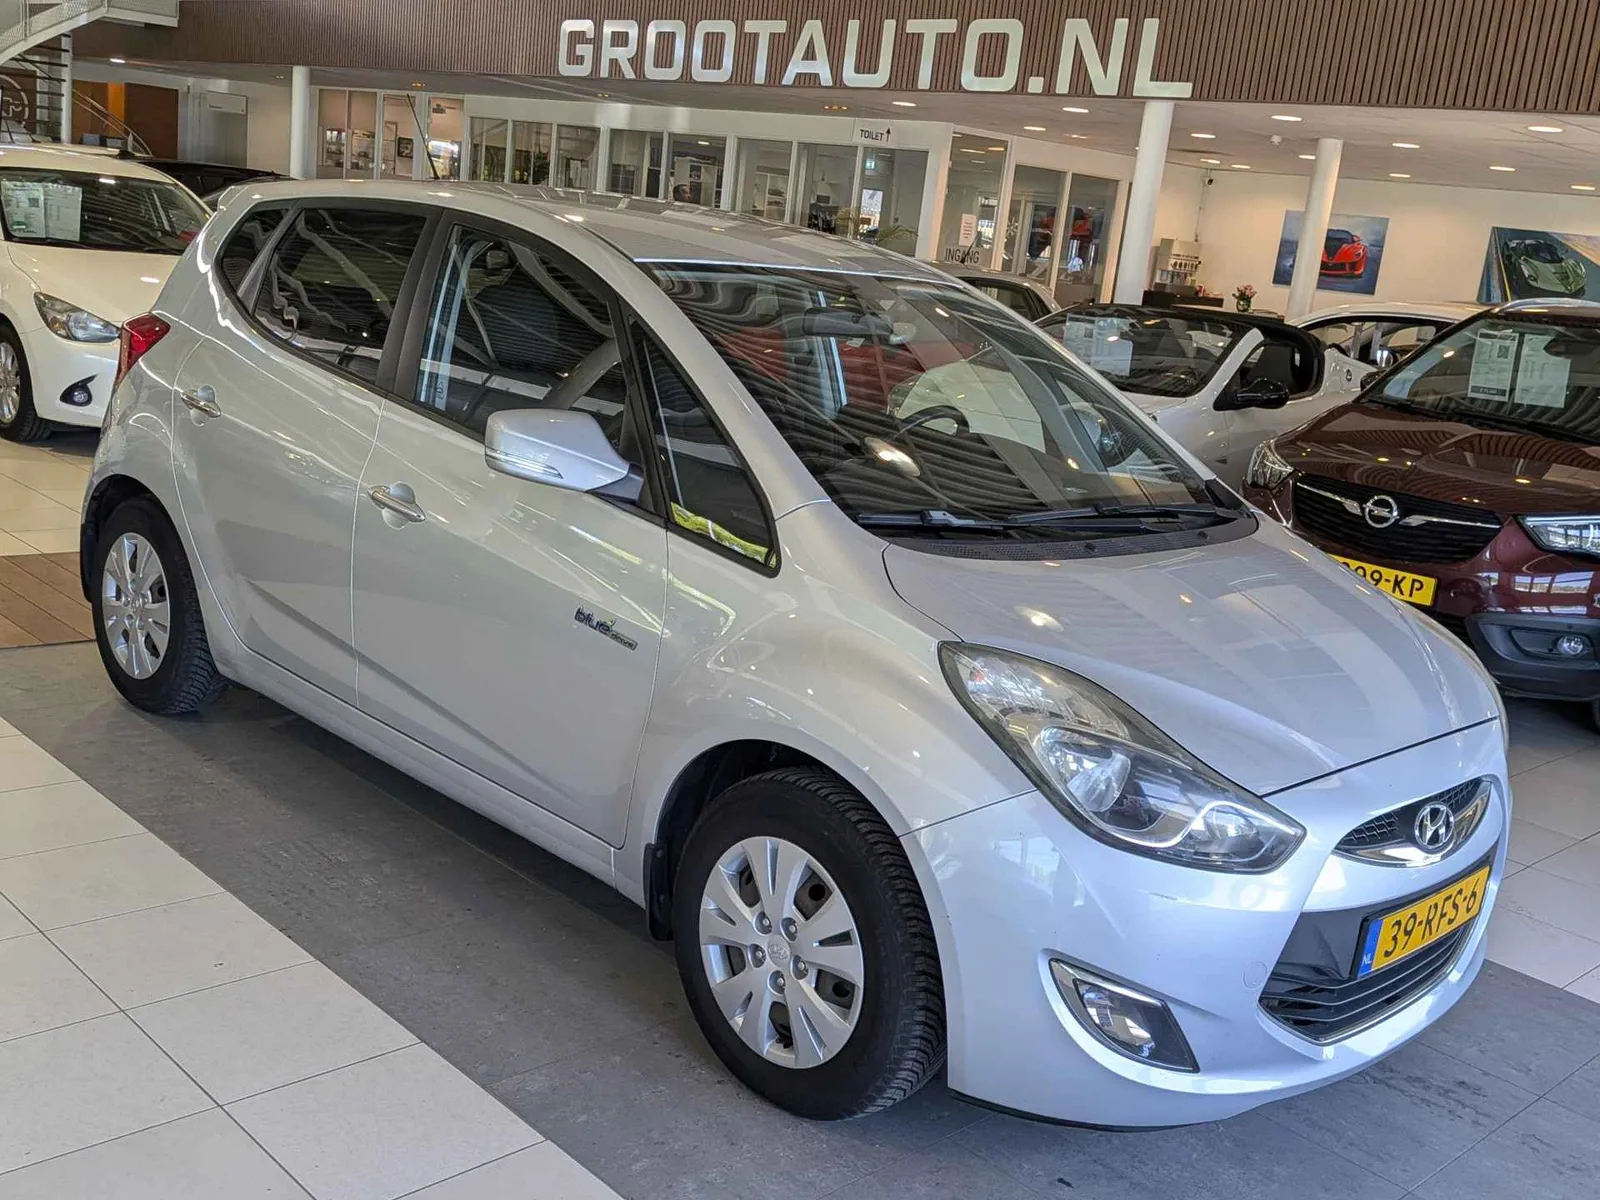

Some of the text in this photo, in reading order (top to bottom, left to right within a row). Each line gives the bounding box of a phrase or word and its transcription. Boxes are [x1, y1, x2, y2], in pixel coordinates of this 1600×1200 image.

[558, 18, 1193, 99] GROOTAUTO.NL
[860, 129, 884, 141] TOILET
[574, 607, 611, 637] blue
[1383, 877, 1480, 958] 39-RFS-6
[1361, 953, 1371, 967] NL
